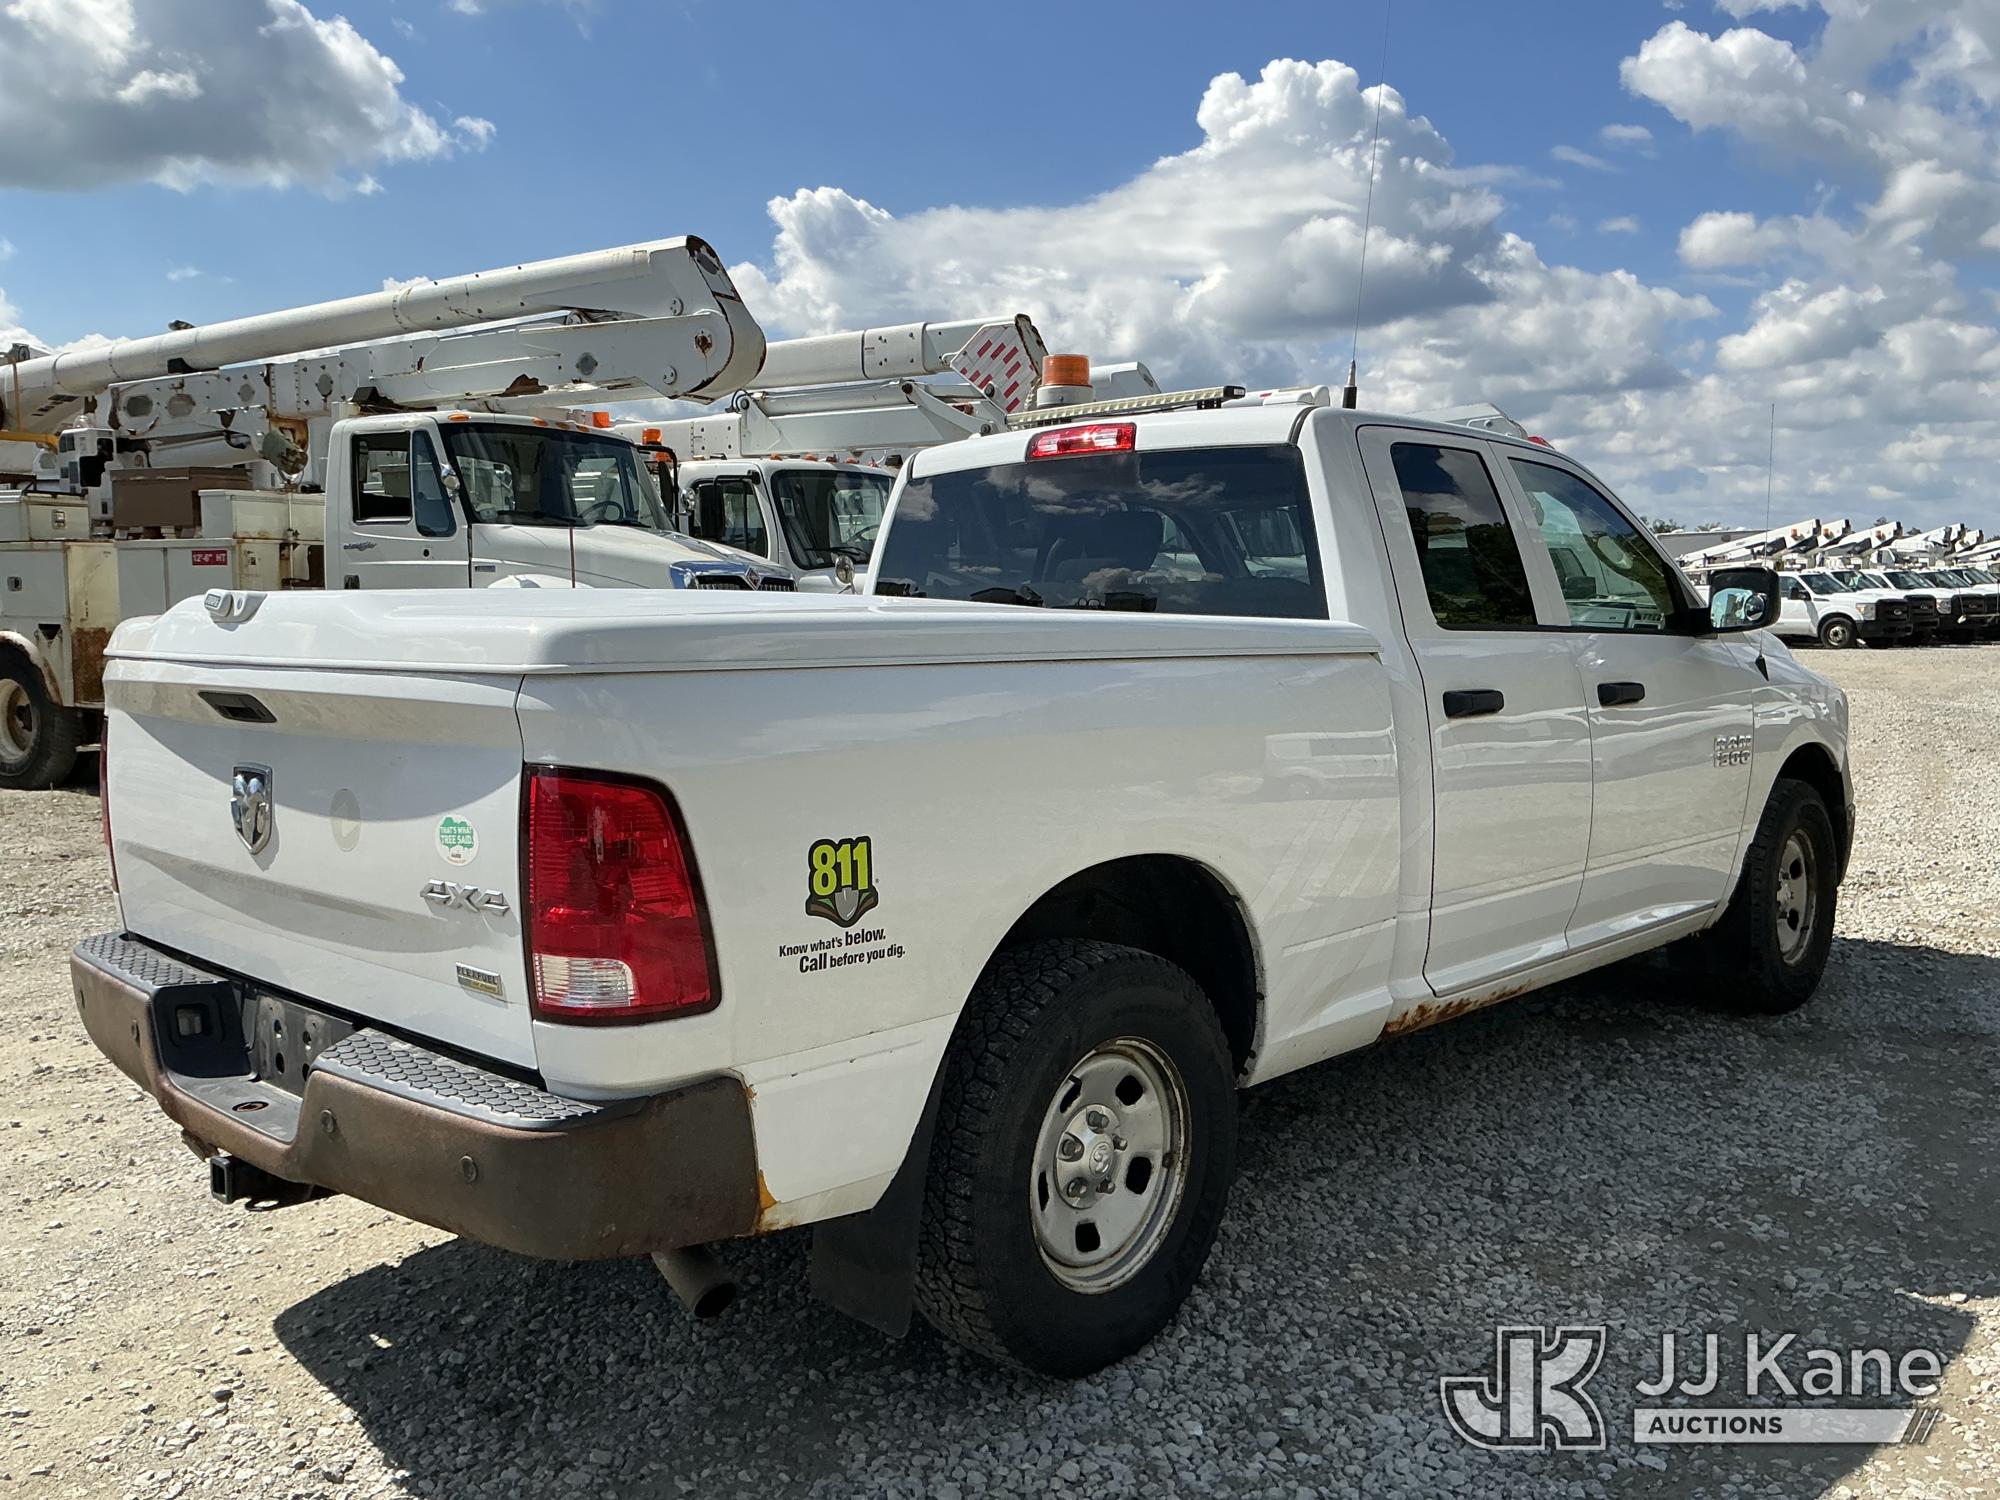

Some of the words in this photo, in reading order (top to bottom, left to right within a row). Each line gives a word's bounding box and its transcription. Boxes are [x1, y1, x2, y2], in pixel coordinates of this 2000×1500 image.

[215, 553, 226, 562] HT
[1714, 735, 1752, 751] RAM
[441, 834, 457, 845] TREE
[812, 841, 869, 896] 811
[779, 944, 808, 957] Know
[810, 937, 843, 953] what's
[845, 928, 886, 947] below.
[799, 952, 827, 974] Call
[830, 952, 865, 969] before
[866, 948, 886, 964] you
[887, 943, 906, 959] dig.
